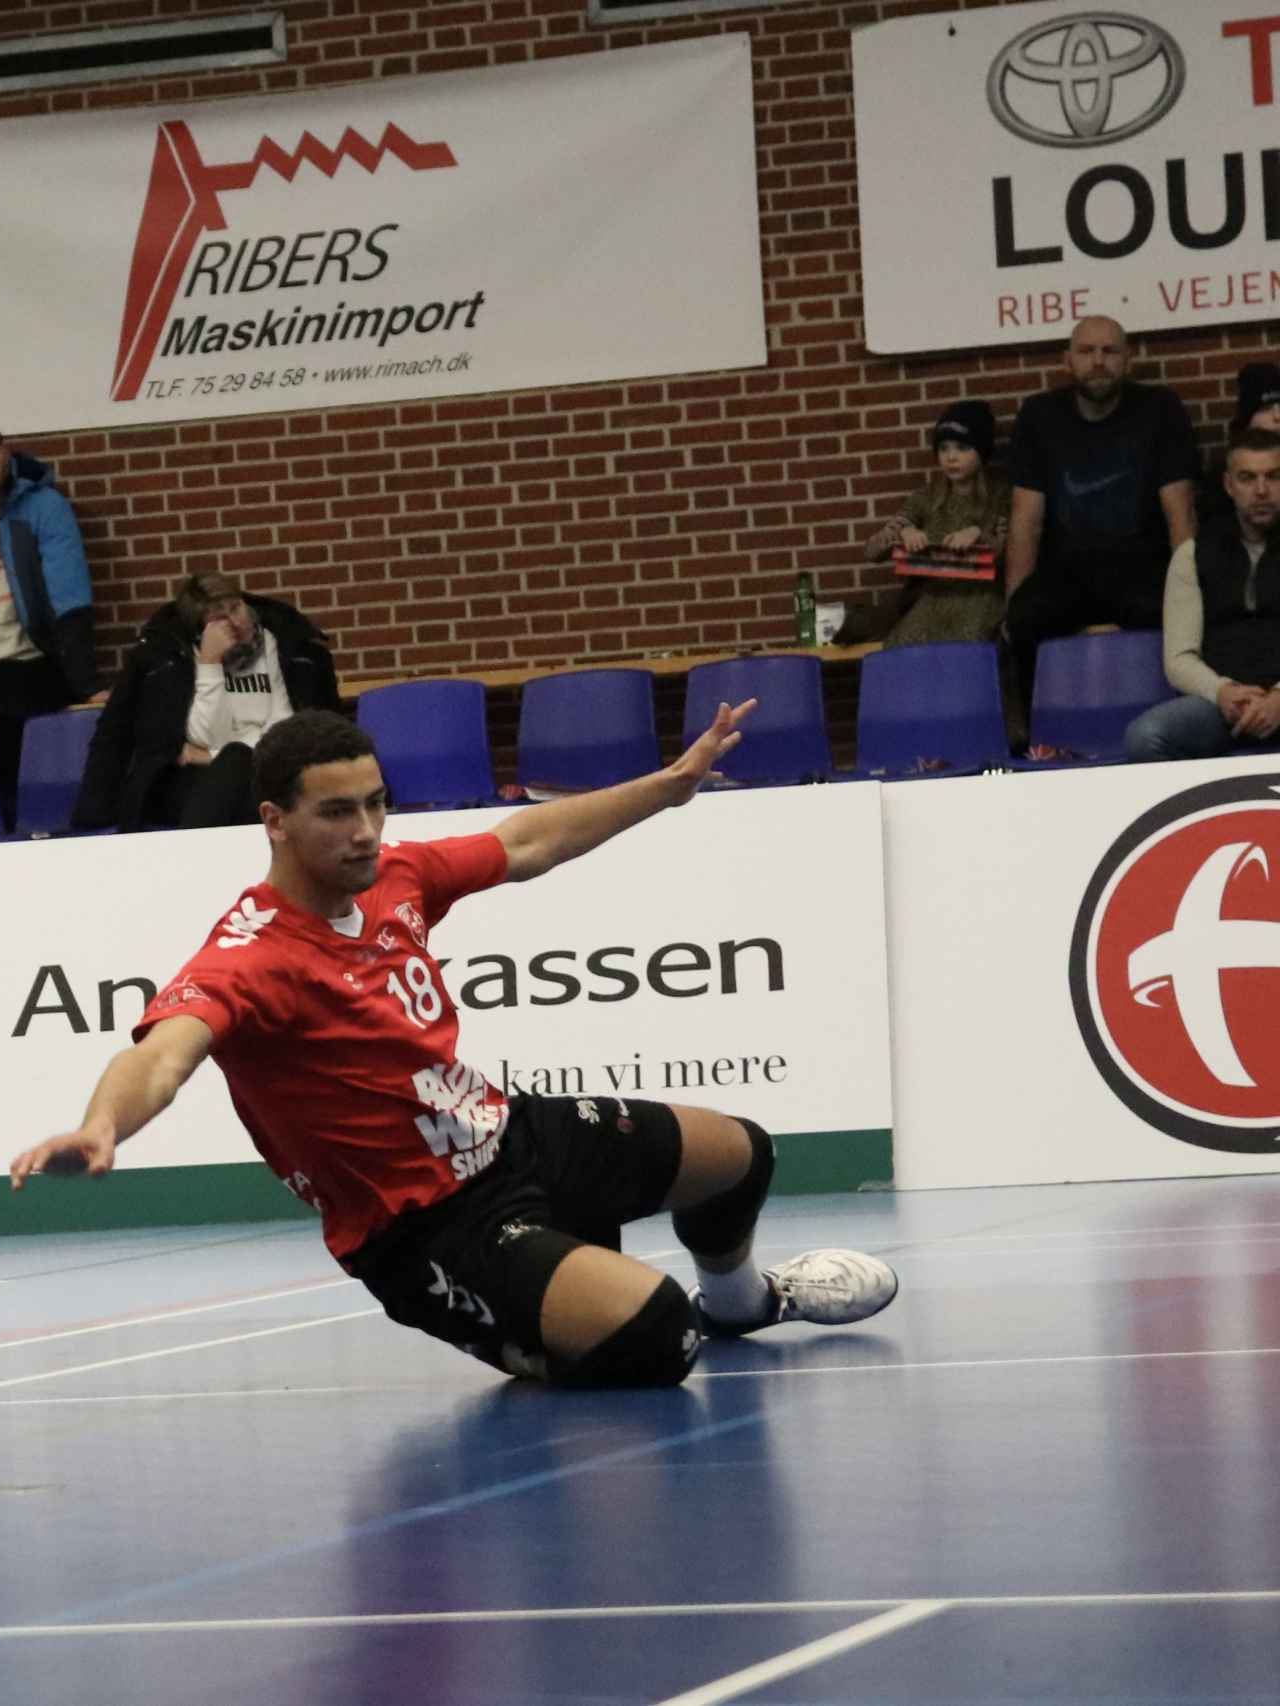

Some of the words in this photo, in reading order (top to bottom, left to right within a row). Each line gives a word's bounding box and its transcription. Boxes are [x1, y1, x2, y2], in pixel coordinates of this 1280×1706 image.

[184, 223, 400, 298] RIBERS
[160, 290, 485, 358] Maskinimport
[997, 288, 1091, 329] RIBE
[191, 375, 217, 396] 75
[219, 372, 247, 394] 29
[249, 370, 276, 391] 84
[280, 366, 307, 388] 58
[323, 351, 473, 383] www.rimach.dk
[224, 672, 272, 694] UMA
[386, 955, 443, 1030] 18
[499, 1058, 585, 1098] kan
[602, 1052, 646, 1092] vi
[661, 1052, 788, 1090] mere
